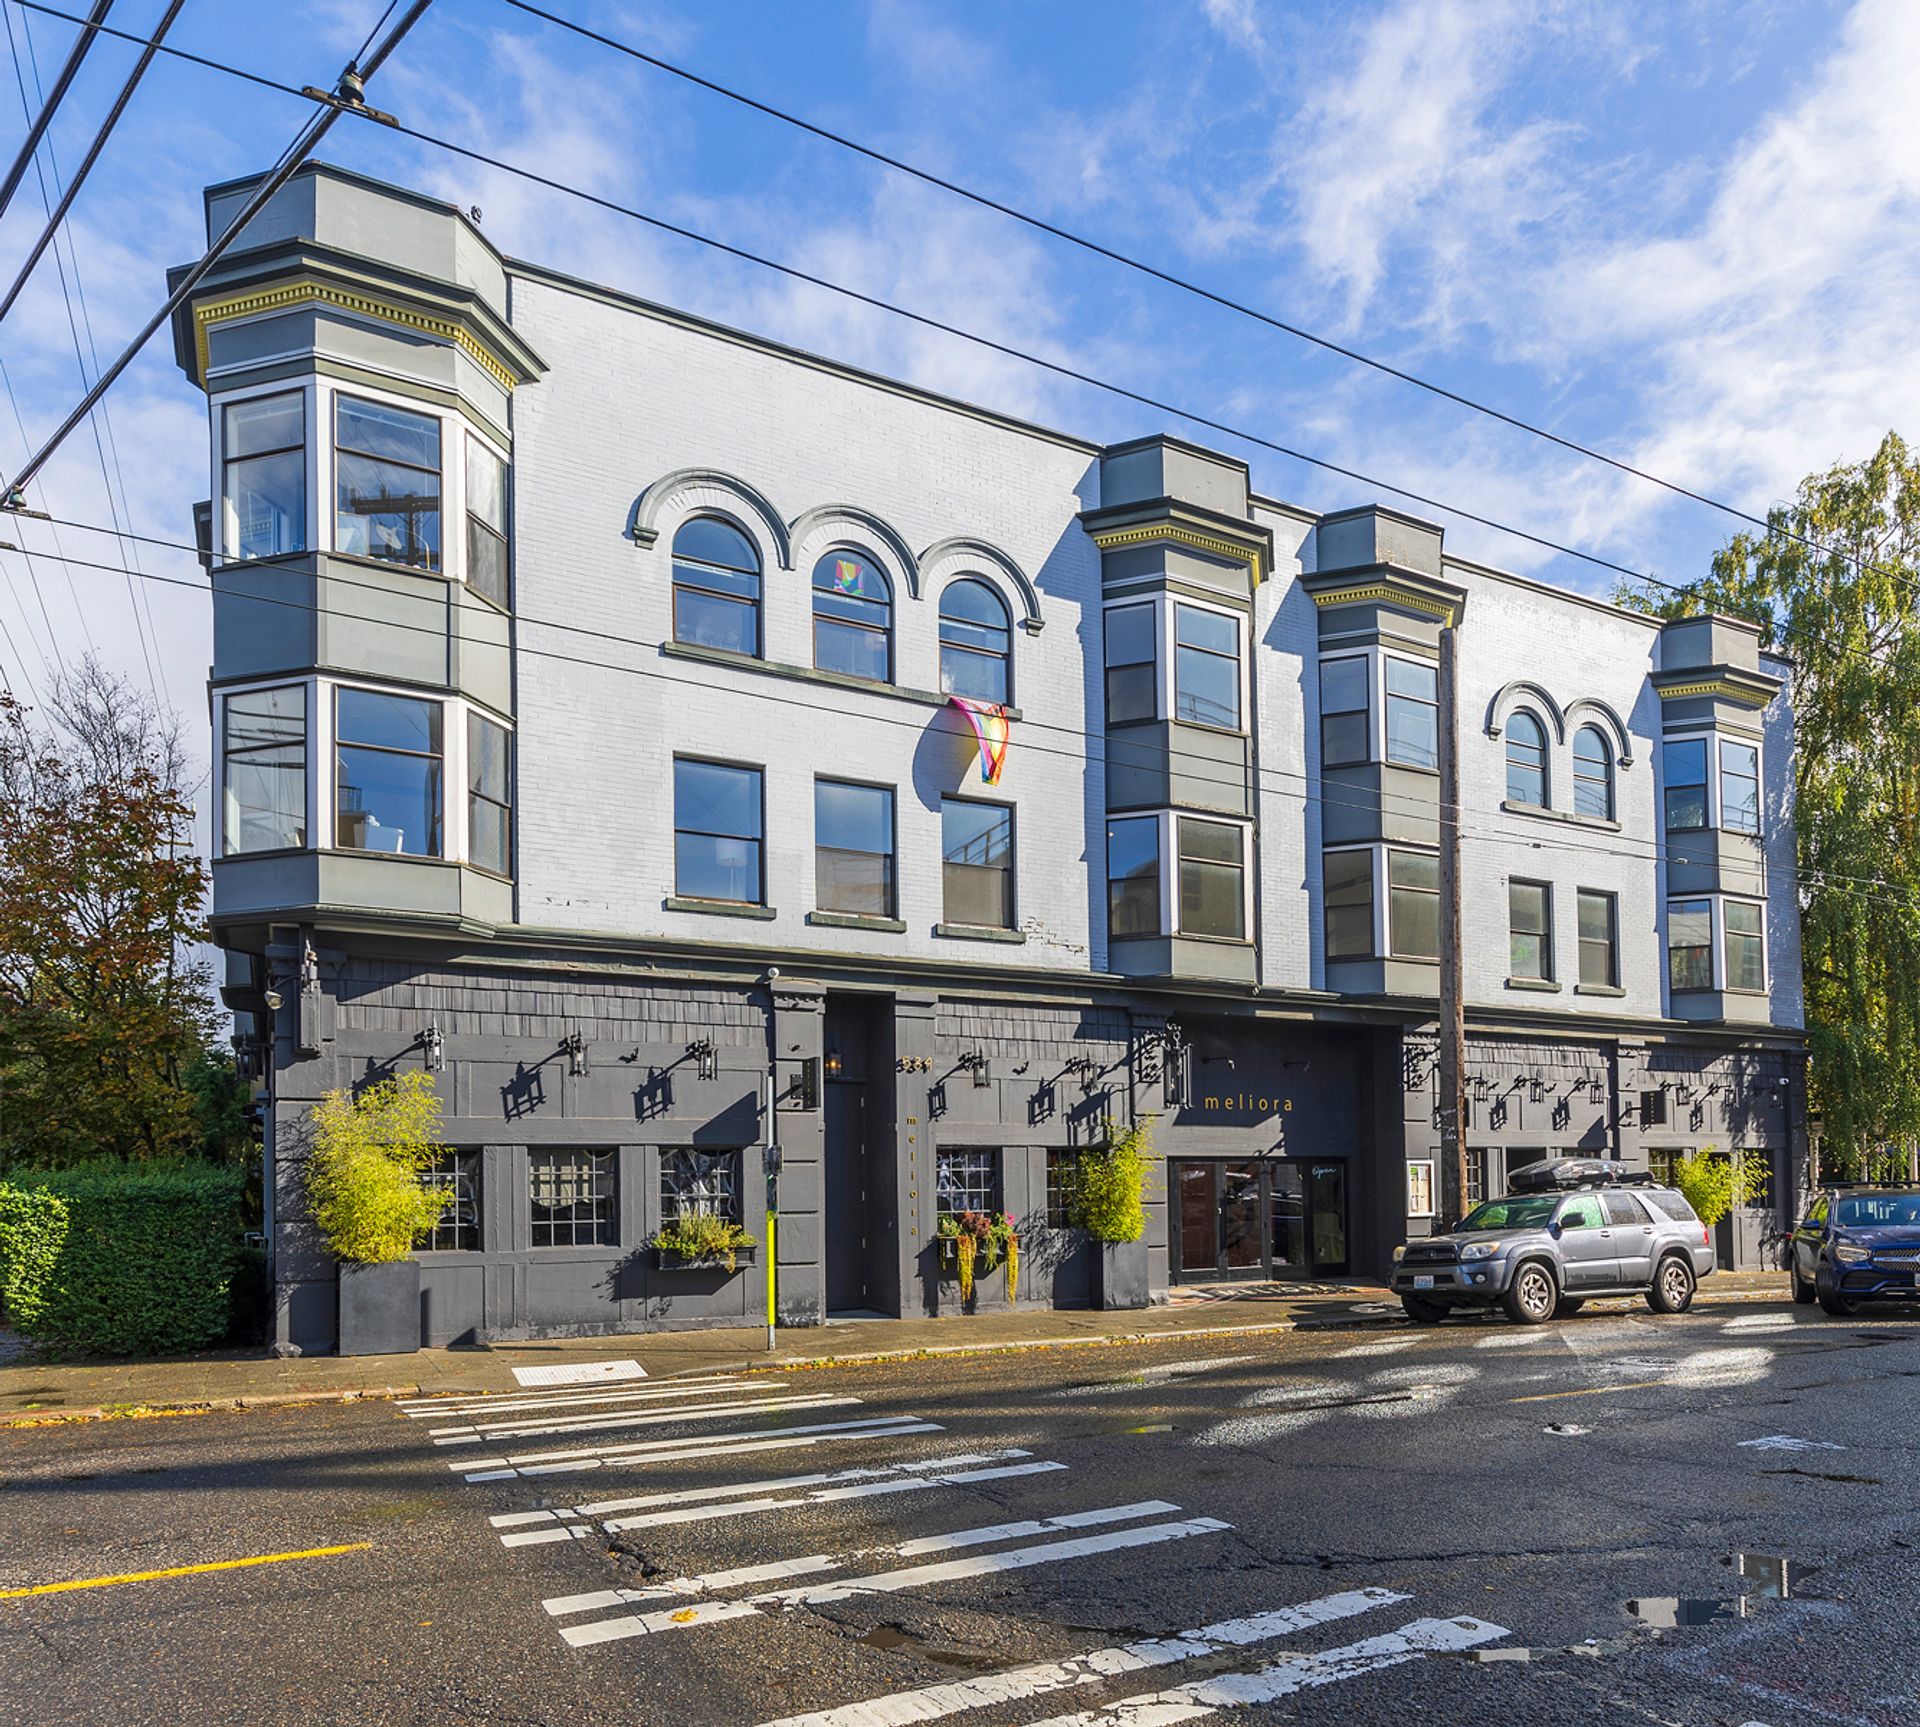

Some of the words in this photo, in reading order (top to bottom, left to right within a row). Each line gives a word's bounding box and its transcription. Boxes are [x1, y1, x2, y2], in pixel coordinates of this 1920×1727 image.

[902, 1055, 933, 1072] 534
[1204, 1093, 1293, 1112] meliora
[1311, 1165, 1338, 1180] Open
